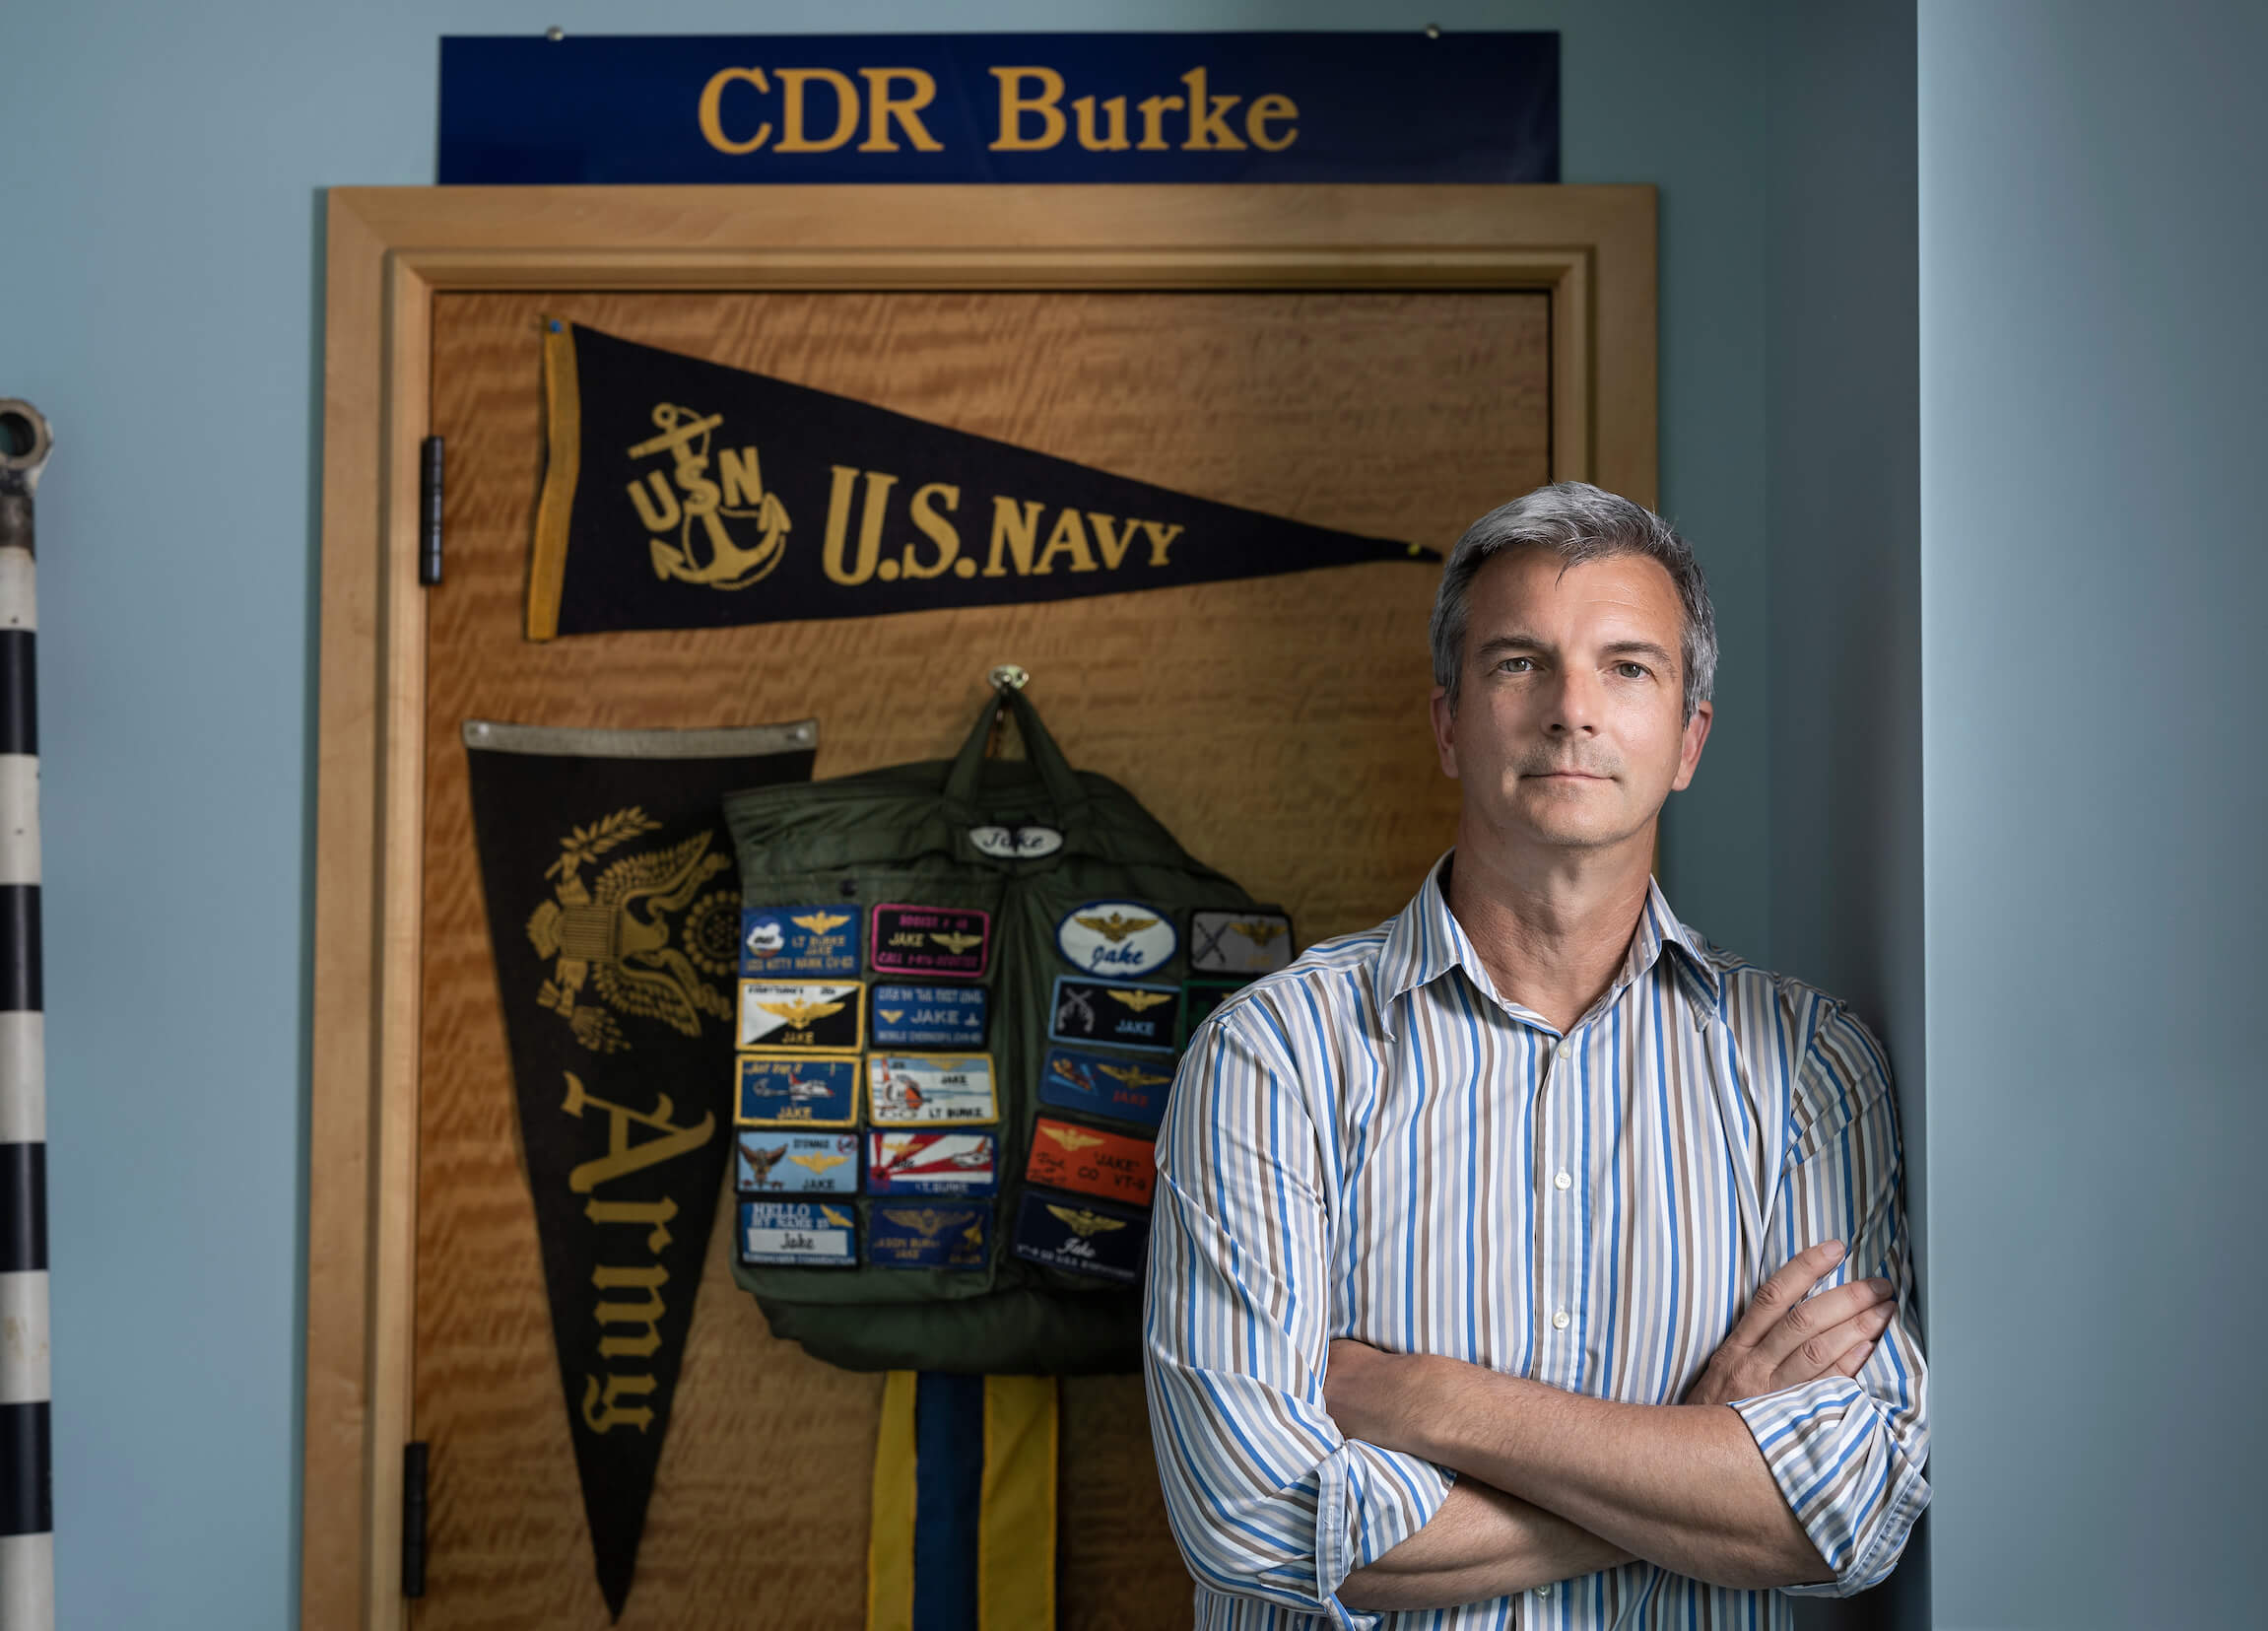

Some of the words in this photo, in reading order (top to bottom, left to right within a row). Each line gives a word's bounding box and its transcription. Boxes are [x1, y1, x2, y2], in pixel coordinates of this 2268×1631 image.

[698, 66, 944, 155] CDR
[988, 66, 1301, 152] Burke
[628, 446, 765, 532] USN
[889, 932, 924, 947] JAKE
[1090, 940, 1144, 971] Jake
[910, 1010, 960, 1025] JAKE
[1114, 1019, 1155, 1036] JAKE
[782, 1031, 814, 1045] JAKE
[942, 1074, 967, 1086] JAKE
[1112, 1090, 1150, 1108] JAKE
[776, 1106, 812, 1121] JAKE
[929, 1108, 942, 1120] LT
[947, 1107, 984, 1120] BURKE
[803, 1179, 835, 1191] JAKE
[753, 1202, 810, 1216] HELLO
[780, 1232, 816, 1251] Jake
[559, 1070, 715, 1435] Army
